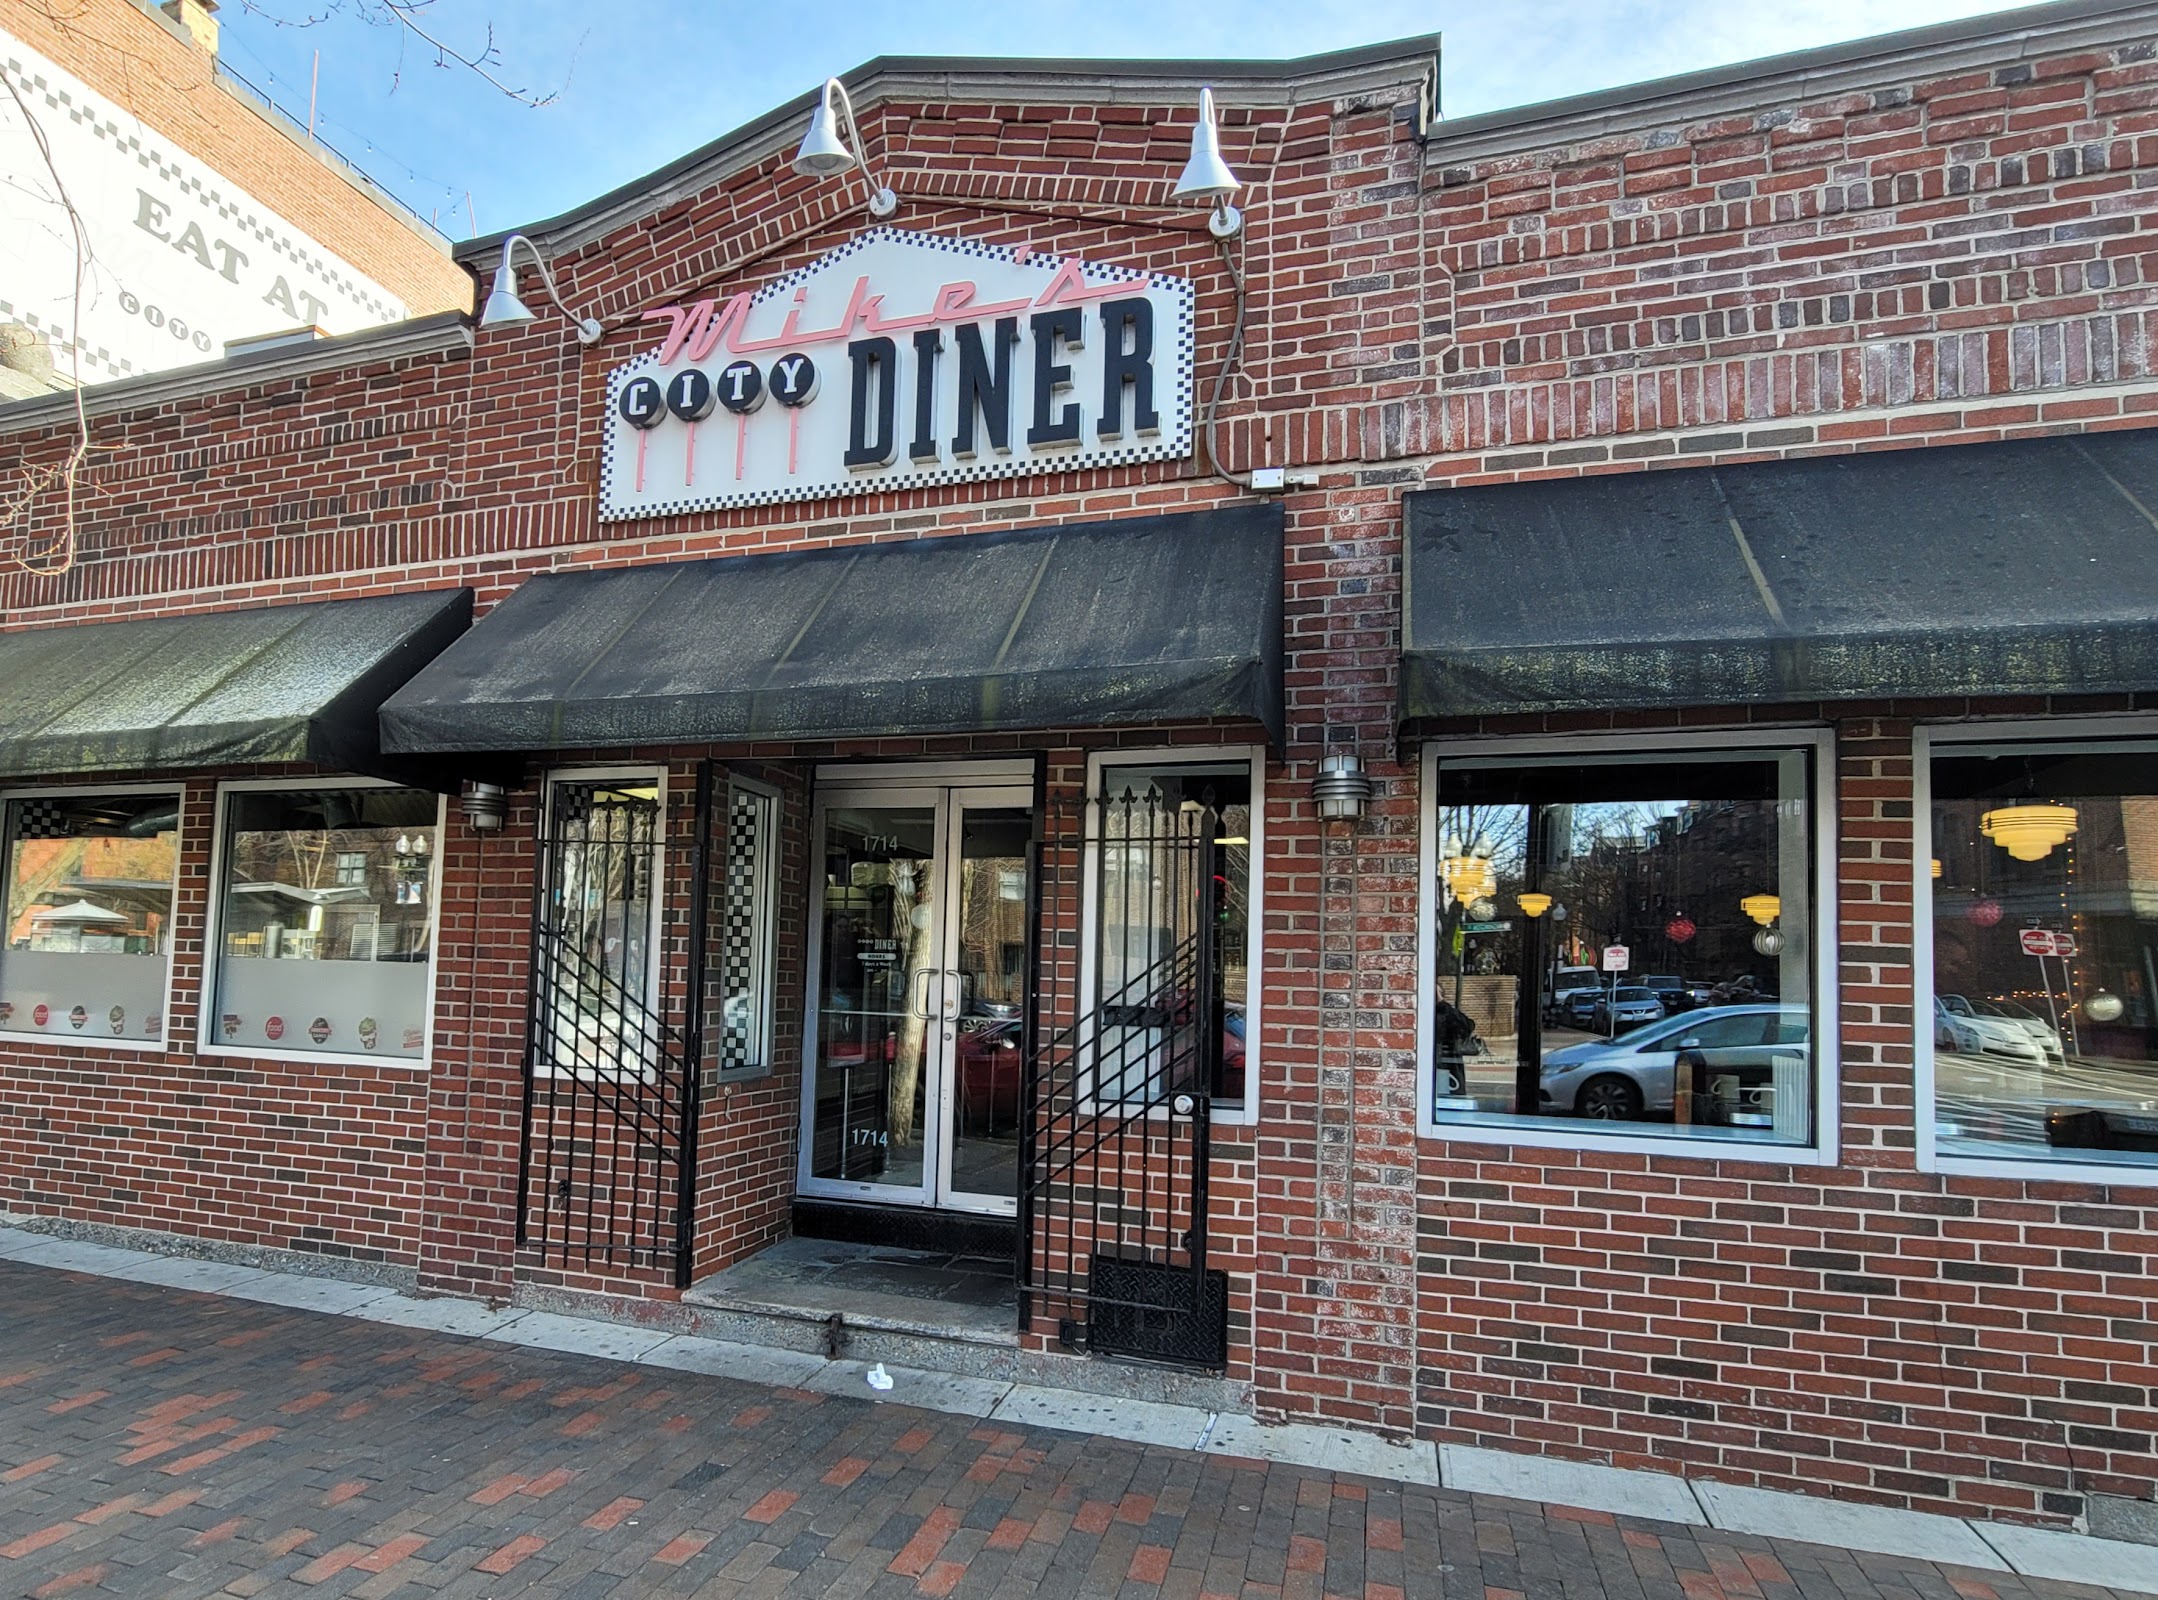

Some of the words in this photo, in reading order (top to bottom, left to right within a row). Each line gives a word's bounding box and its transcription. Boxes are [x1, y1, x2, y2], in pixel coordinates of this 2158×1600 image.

[133, 187, 250, 285] EAT
[261, 274, 329, 325] AT
[120, 292, 211, 352] CITY
[640, 245, 1150, 366] Mike's
[626, 356, 807, 418] CITY
[843, 295, 1163, 472] DINER
[862, 835, 899, 852] 1714
[874, 938, 897, 950] DINER
[262, 1021, 283, 1035] food
[852, 1128, 888, 1147] 1714
